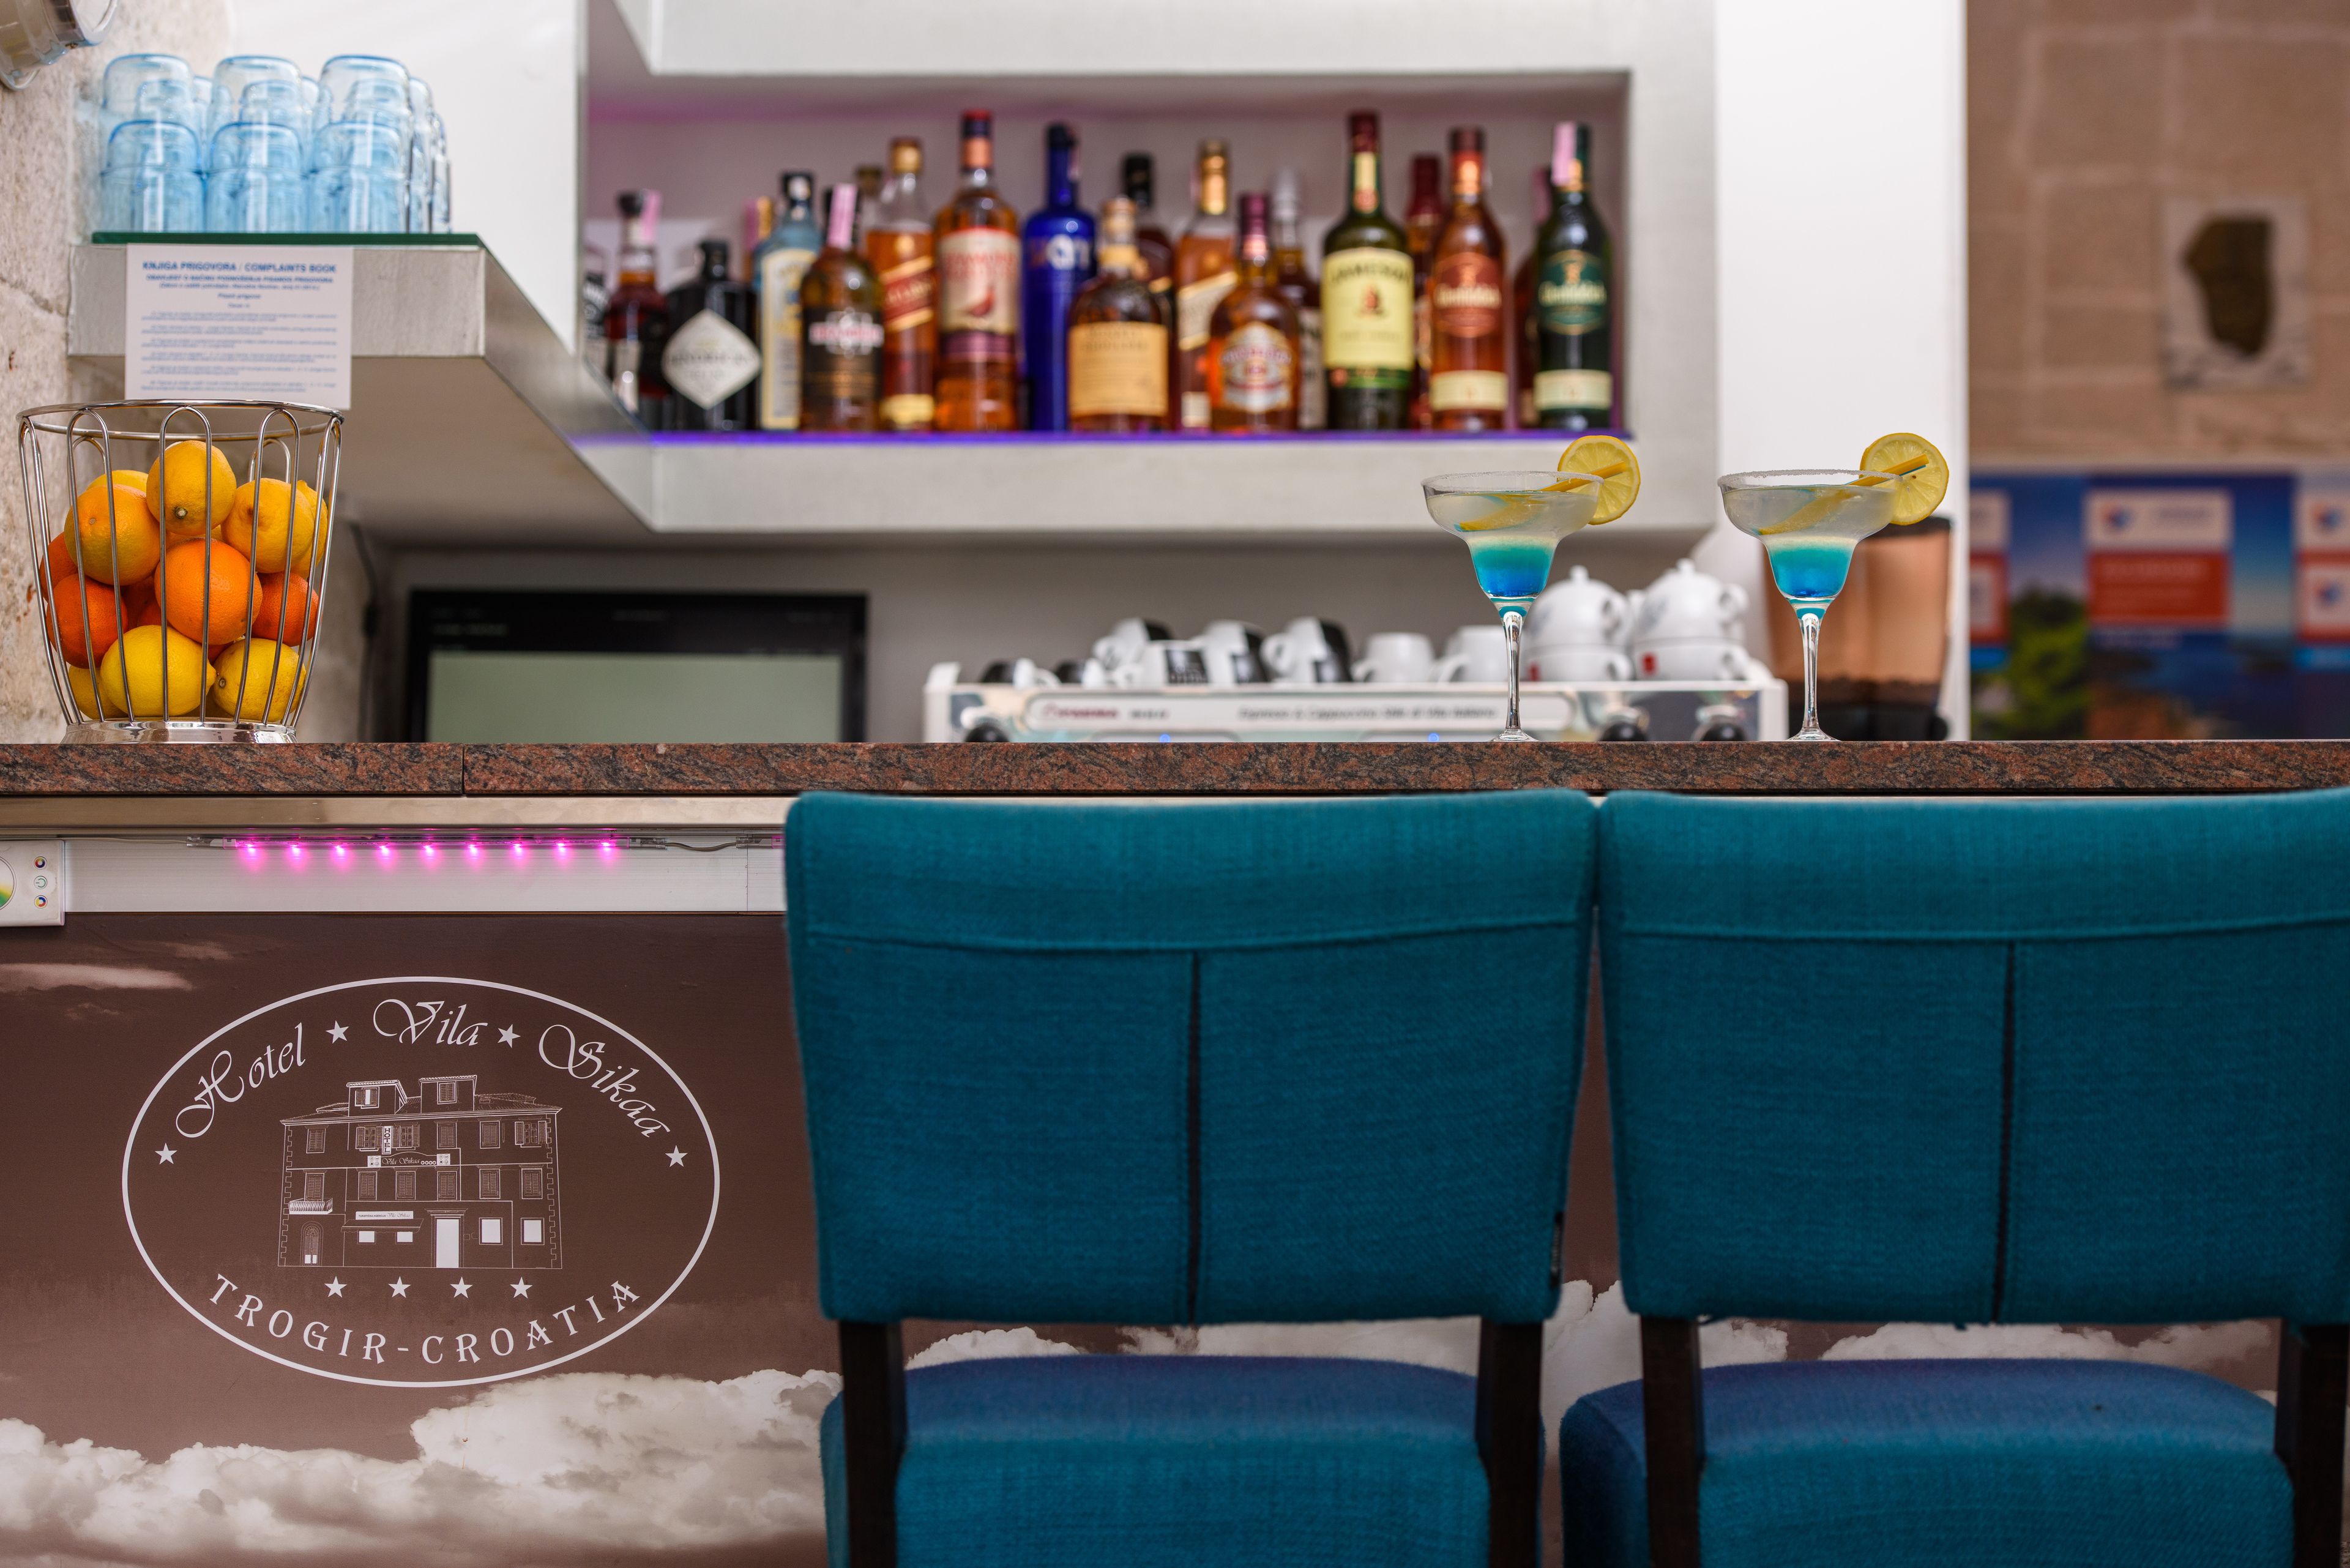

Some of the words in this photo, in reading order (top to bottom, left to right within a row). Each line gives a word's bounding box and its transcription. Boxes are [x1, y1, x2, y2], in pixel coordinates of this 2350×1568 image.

[141, 261, 178, 271] KNJIGA
[180, 262, 237, 272] PRIGOVORA
[244, 263, 306, 273] COMPLAINTS
[309, 264, 336, 273] BOOK
[176, 1022, 306, 1138] Hotel
[373, 999, 488, 1046] Vila
[539, 1025, 671, 1138] Sikaa
